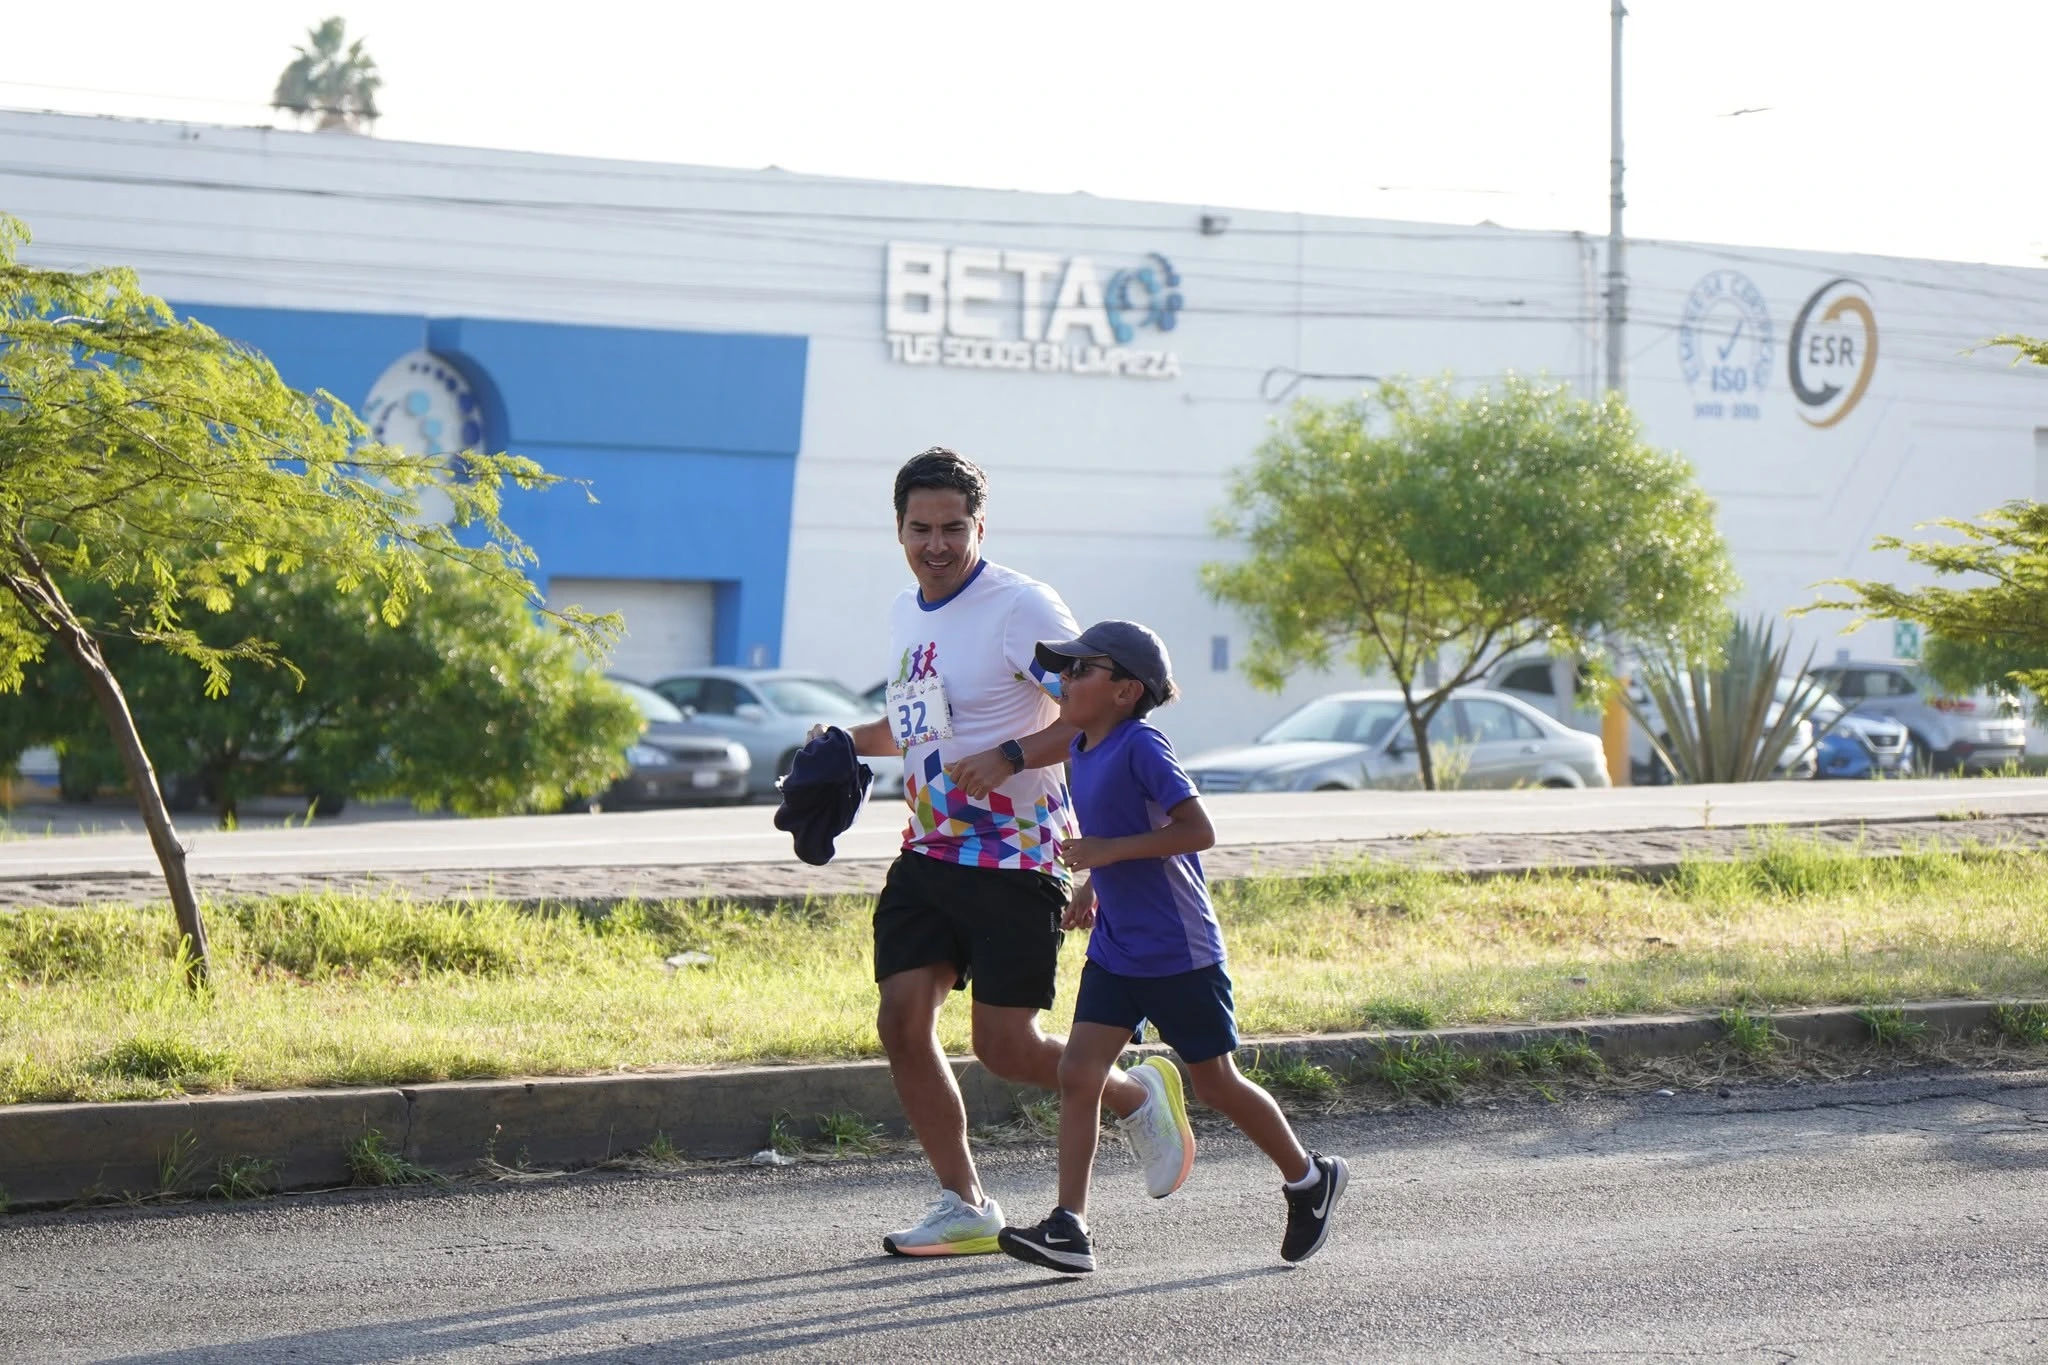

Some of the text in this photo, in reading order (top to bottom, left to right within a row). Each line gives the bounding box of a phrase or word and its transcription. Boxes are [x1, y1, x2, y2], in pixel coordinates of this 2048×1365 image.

[886, 240, 1117, 346] BETA
[889, 333, 938, 365] TUS
[1035, 343, 1069, 373] EN
[1809, 335, 1855, 366] ESR
[1711, 366, 1748, 393] ISO
[898, 700, 928, 738] 32
